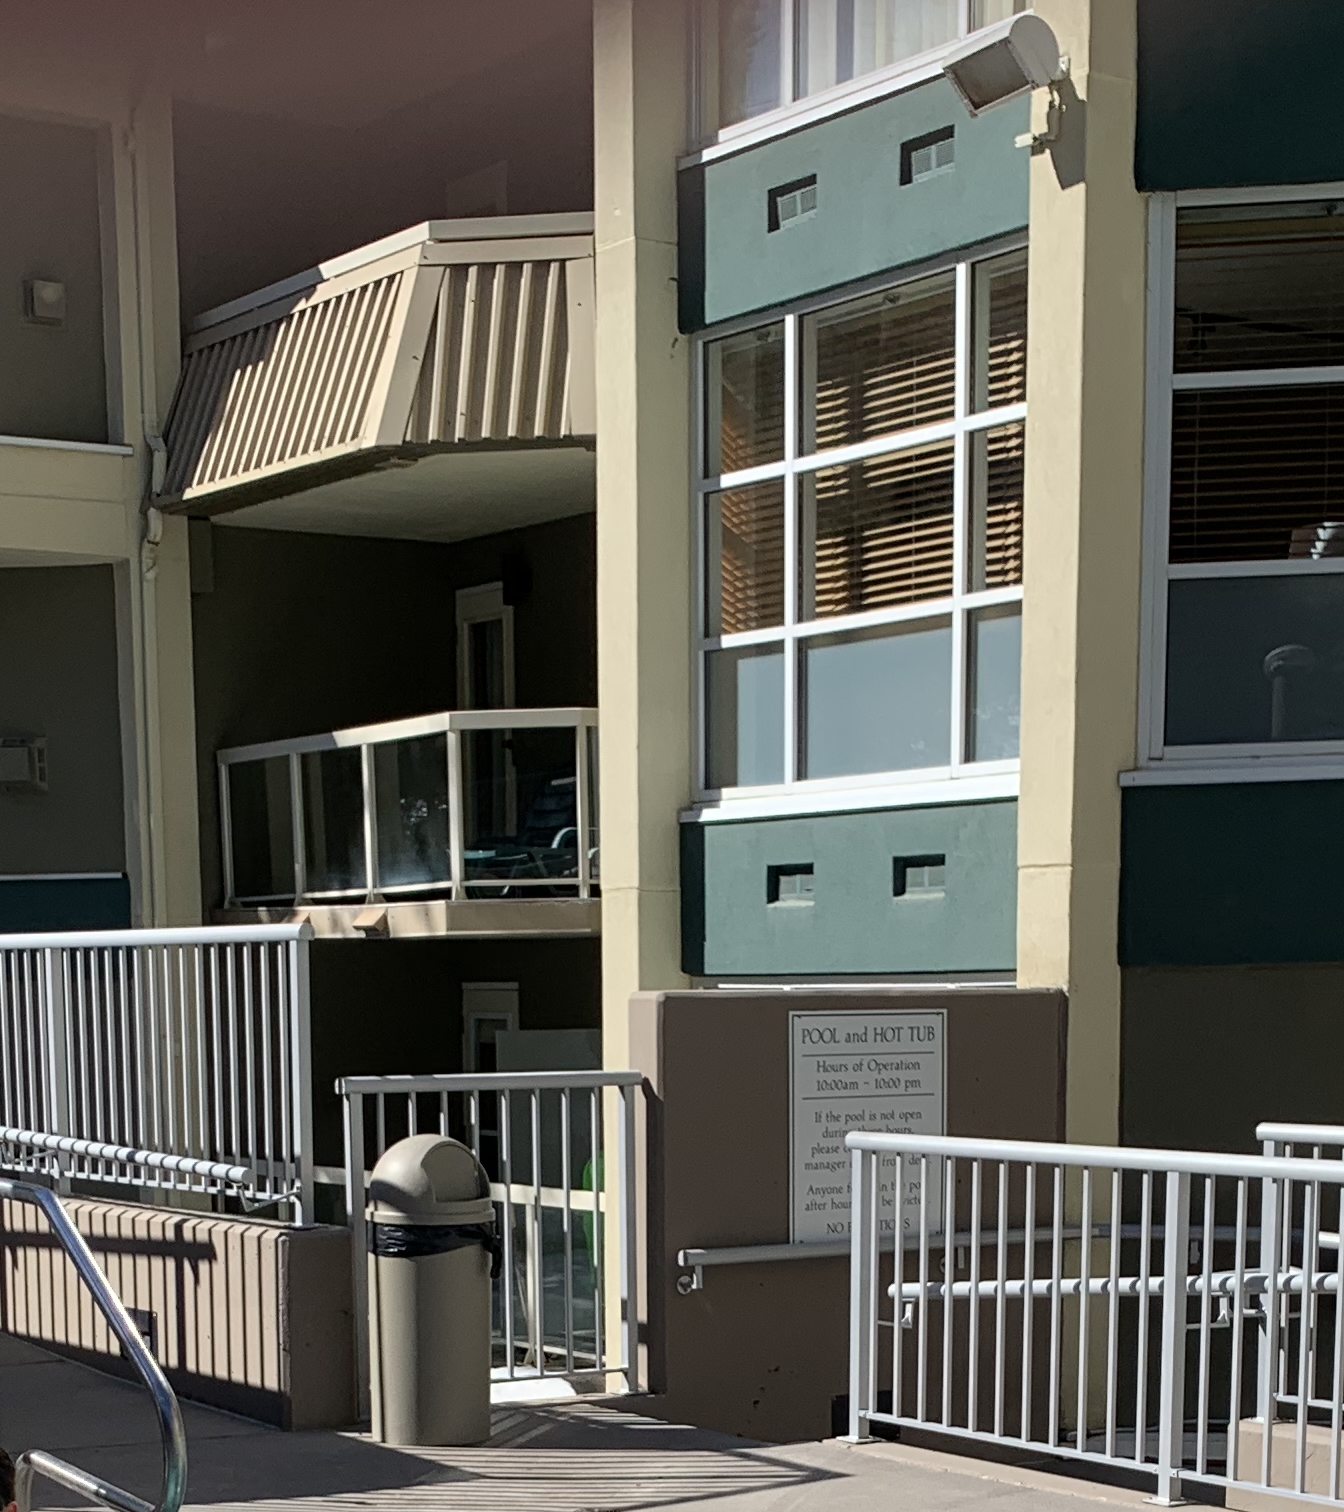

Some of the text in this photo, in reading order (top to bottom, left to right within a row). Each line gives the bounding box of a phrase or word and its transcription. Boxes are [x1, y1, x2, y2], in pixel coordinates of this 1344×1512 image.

[801, 1026, 935, 1044] POOL and HOT TUB
[816, 1059, 921, 1075] Hours of Operation
[816, 1079, 859, 1092] 10:00am
[874, 1077, 901, 1090] 10:00
[904, 1078, 921, 1092] pm
[814, 1109, 923, 1125] If the pool is not open
[822, 1126, 850, 1139] durin
[811, 1142, 840, 1158] please
[804, 1160, 846, 1173] manager
[806, 1184, 844, 1198] Anyone
[805, 1199, 828, 1211] after
[831, 1197, 851, 1210] hour
[882, 1195, 894, 1207] be
[826, 1221, 844, 1234] NO
